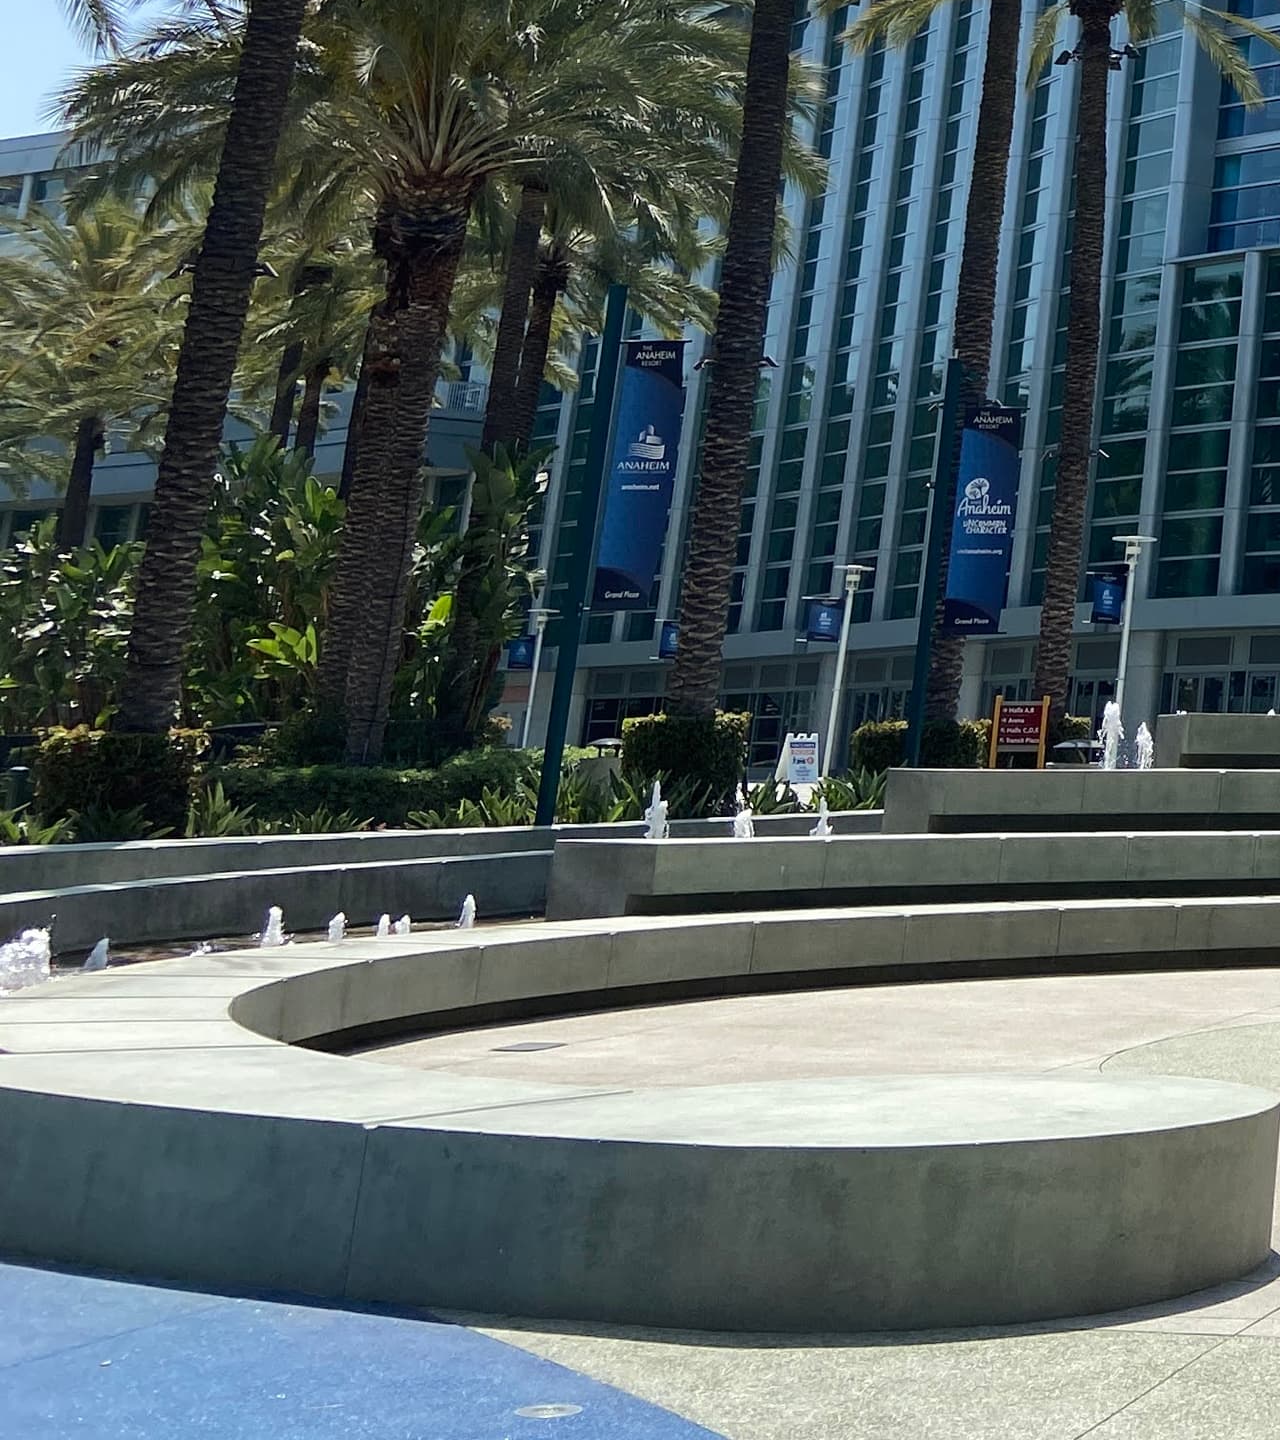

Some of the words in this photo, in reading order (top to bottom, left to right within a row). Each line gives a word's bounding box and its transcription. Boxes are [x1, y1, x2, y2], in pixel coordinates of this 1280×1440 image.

[635, 351, 676, 360] ANAHEIM
[973, 416, 1013, 424] ANAHEIM
[616, 461, 670, 470] ANAHEIM
[957, 494, 1012, 517] Anaheim
[965, 526, 1008, 534] CHARACTER
[604, 590, 623, 599] Grand
